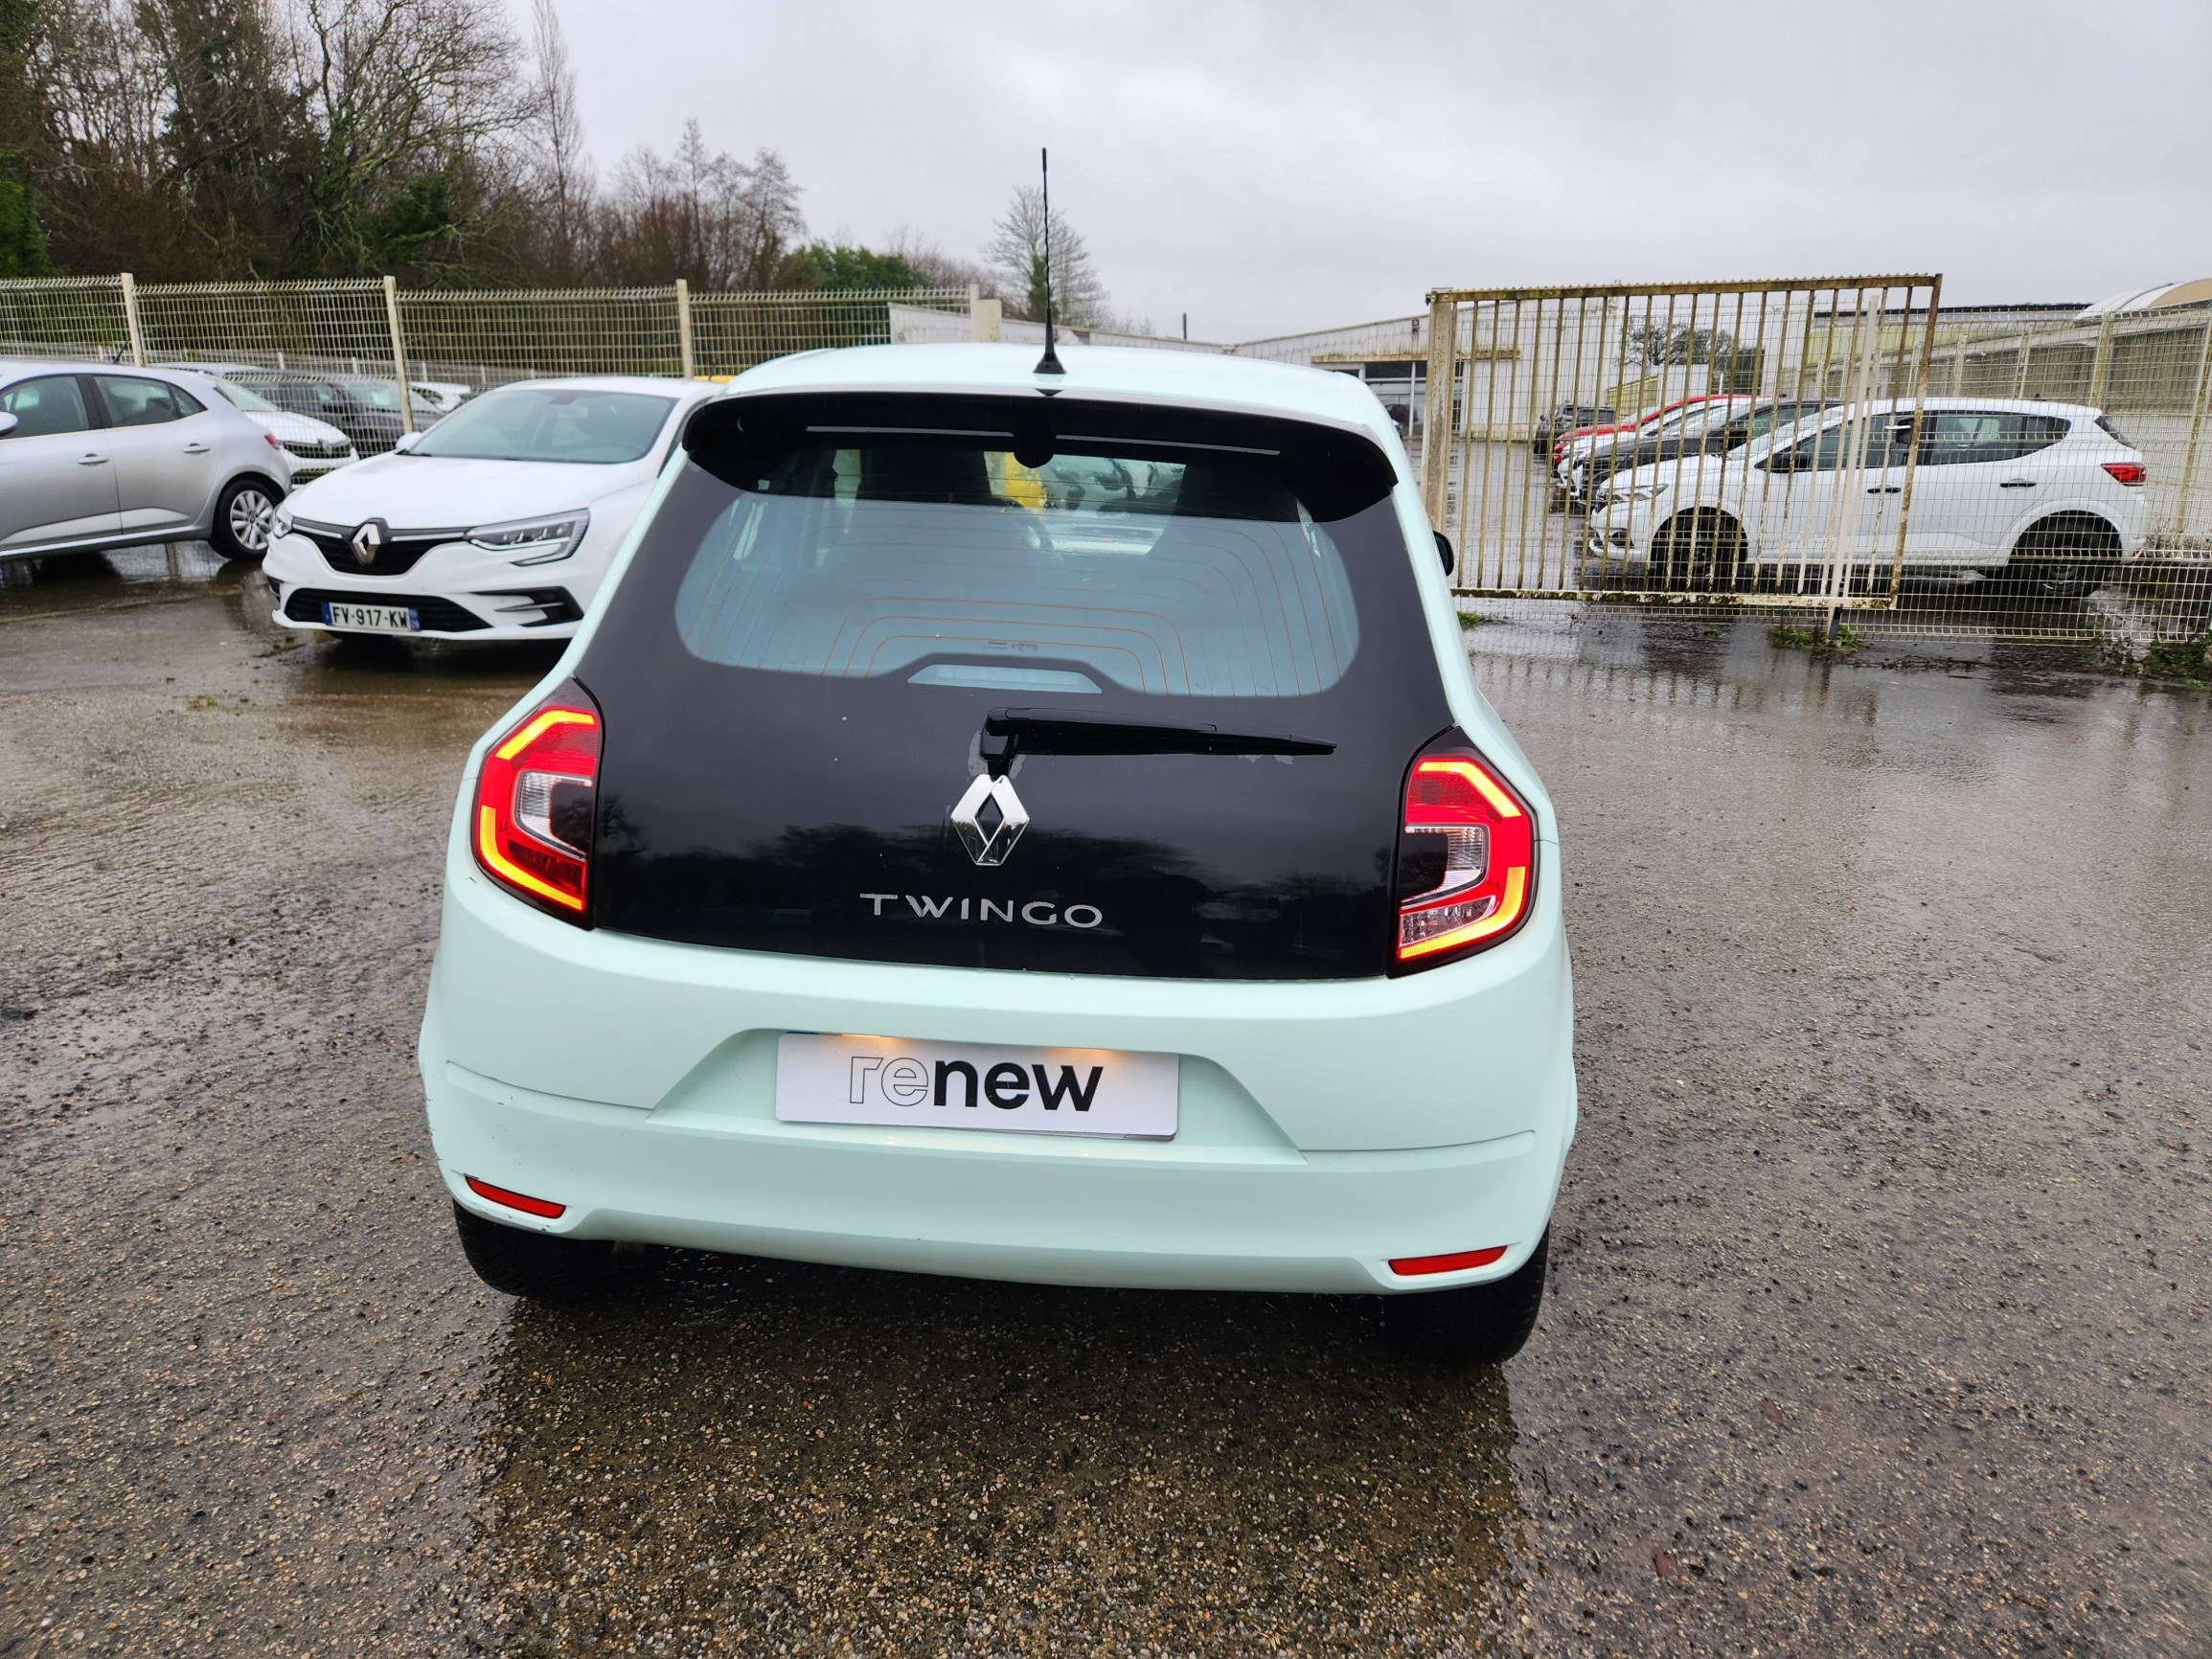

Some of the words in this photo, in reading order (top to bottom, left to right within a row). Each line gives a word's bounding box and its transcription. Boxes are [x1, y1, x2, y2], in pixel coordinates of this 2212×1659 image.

[332, 606, 408, 628] FV-917-KW
[859, 893, 1103, 928] TWINGO
[849, 1056, 1105, 1112] renew
